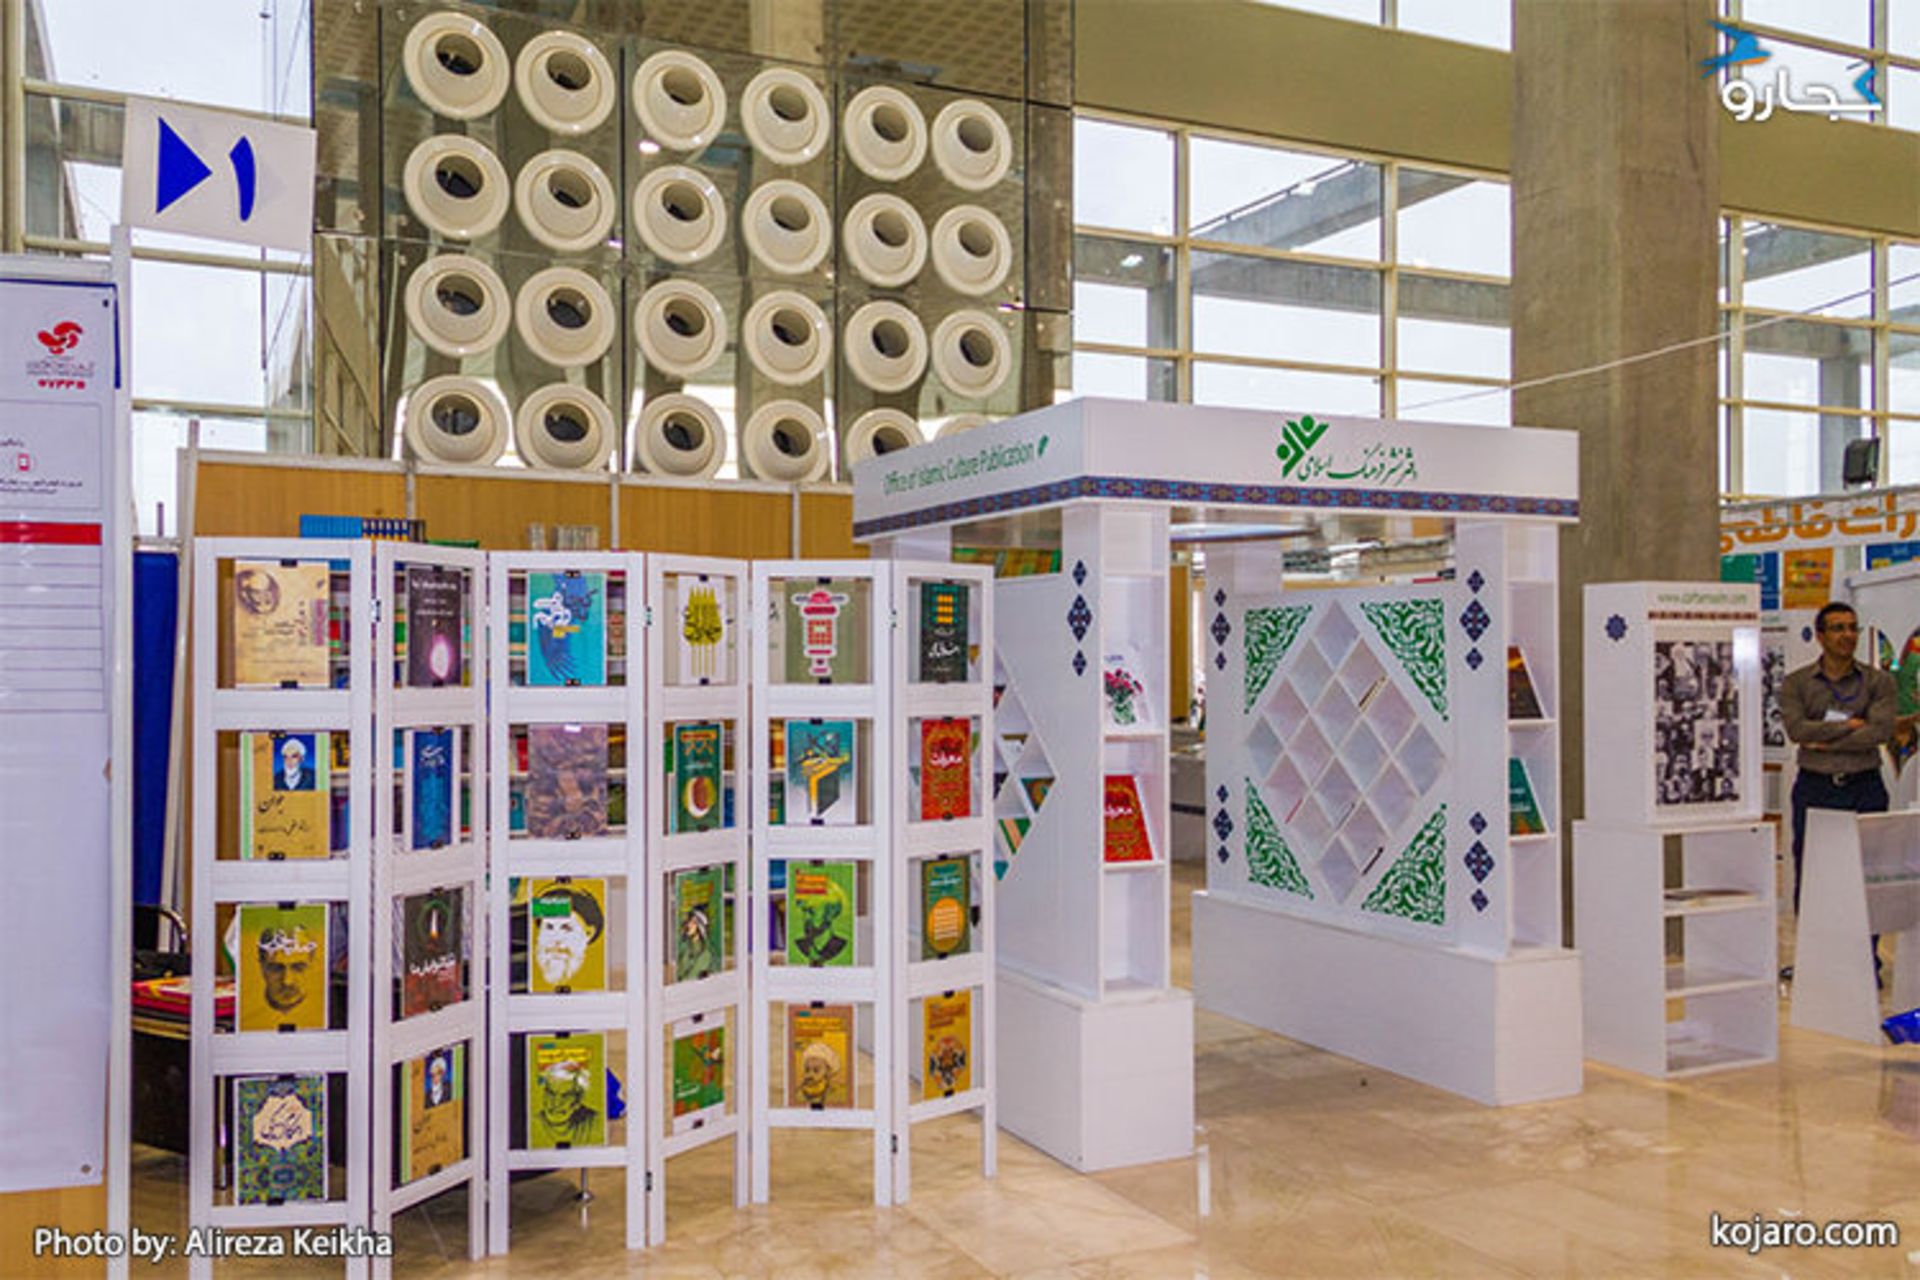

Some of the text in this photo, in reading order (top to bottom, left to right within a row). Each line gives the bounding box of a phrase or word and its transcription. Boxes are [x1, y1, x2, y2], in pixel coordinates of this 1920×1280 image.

[883, 470, 907, 495] Office
[919, 463, 945, 487] Islamic
[947, 456, 979, 480] Culture
[980, 442, 1035, 473] Publication
